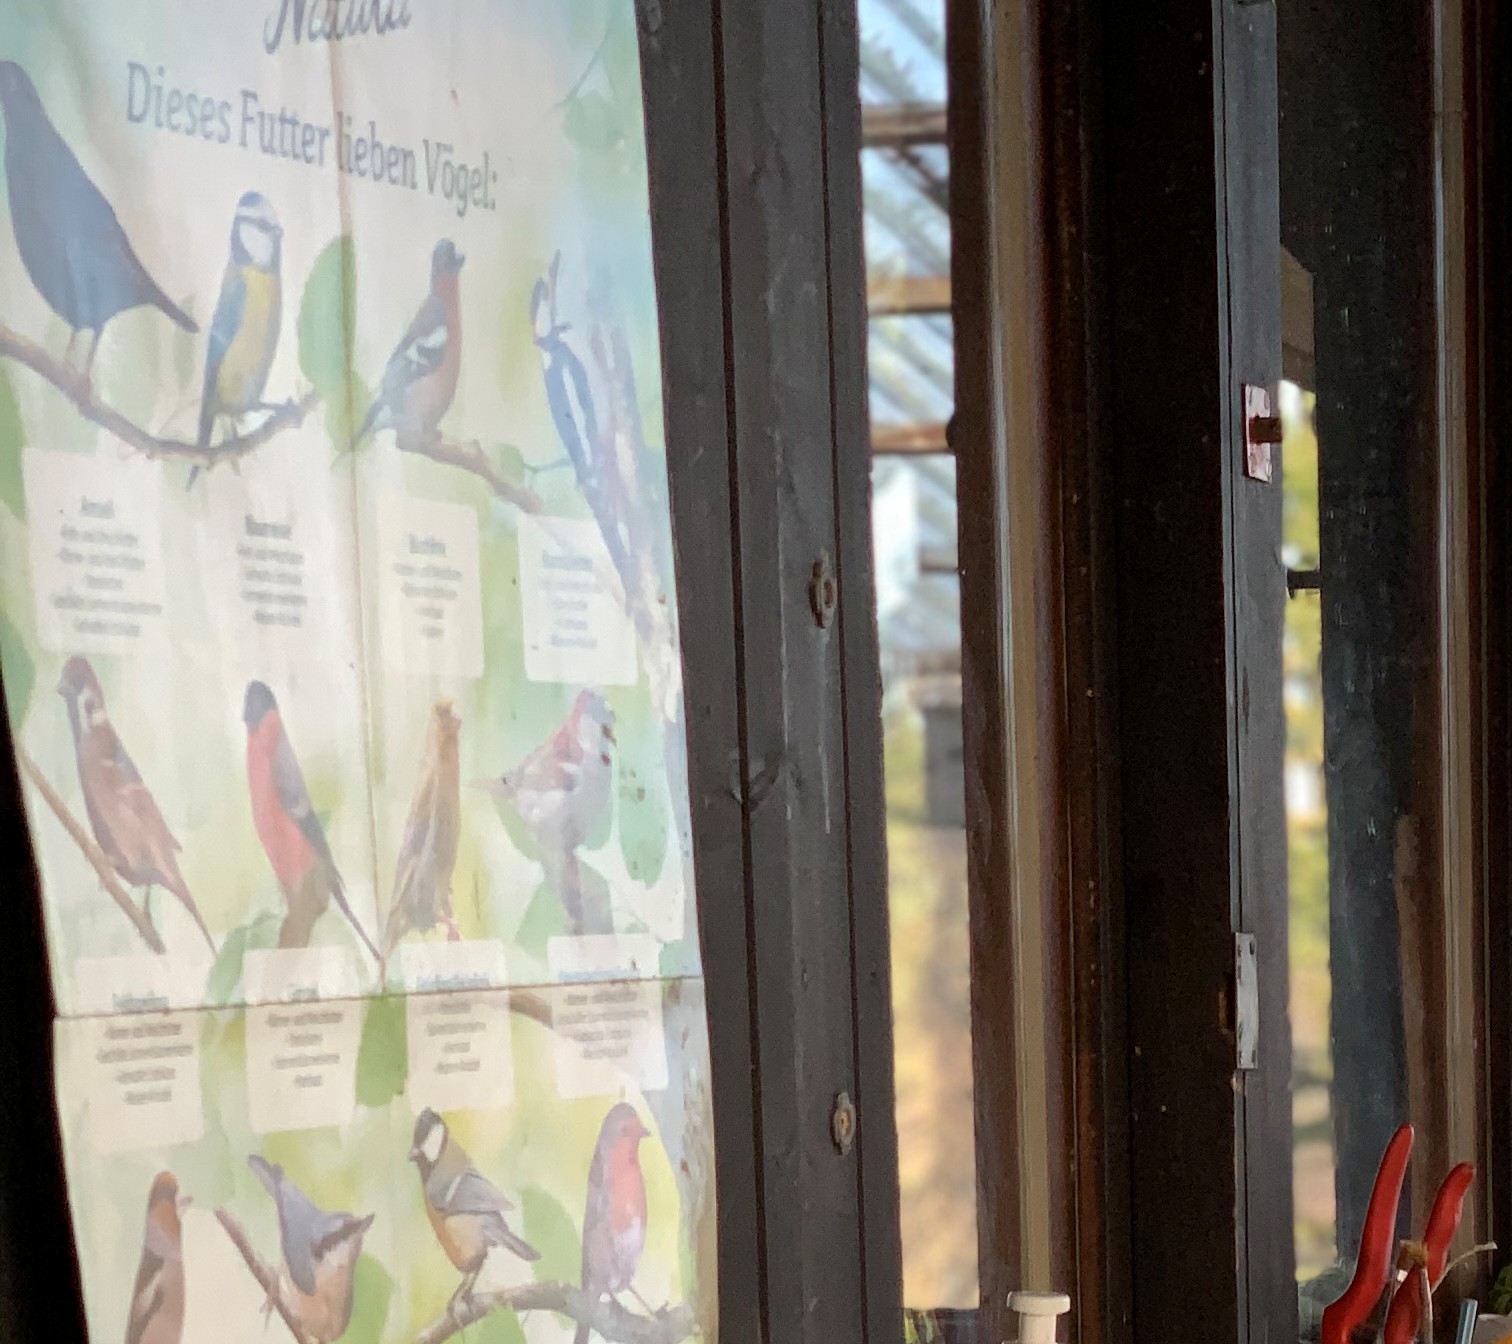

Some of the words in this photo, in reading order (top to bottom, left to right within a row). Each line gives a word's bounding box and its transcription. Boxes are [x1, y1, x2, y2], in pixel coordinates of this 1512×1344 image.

[126, 61, 232, 145] Dieses
[239, 88, 330, 167] Futter
[335, 110, 418, 190] lieben
[422, 138, 498, 218] Vögel:
